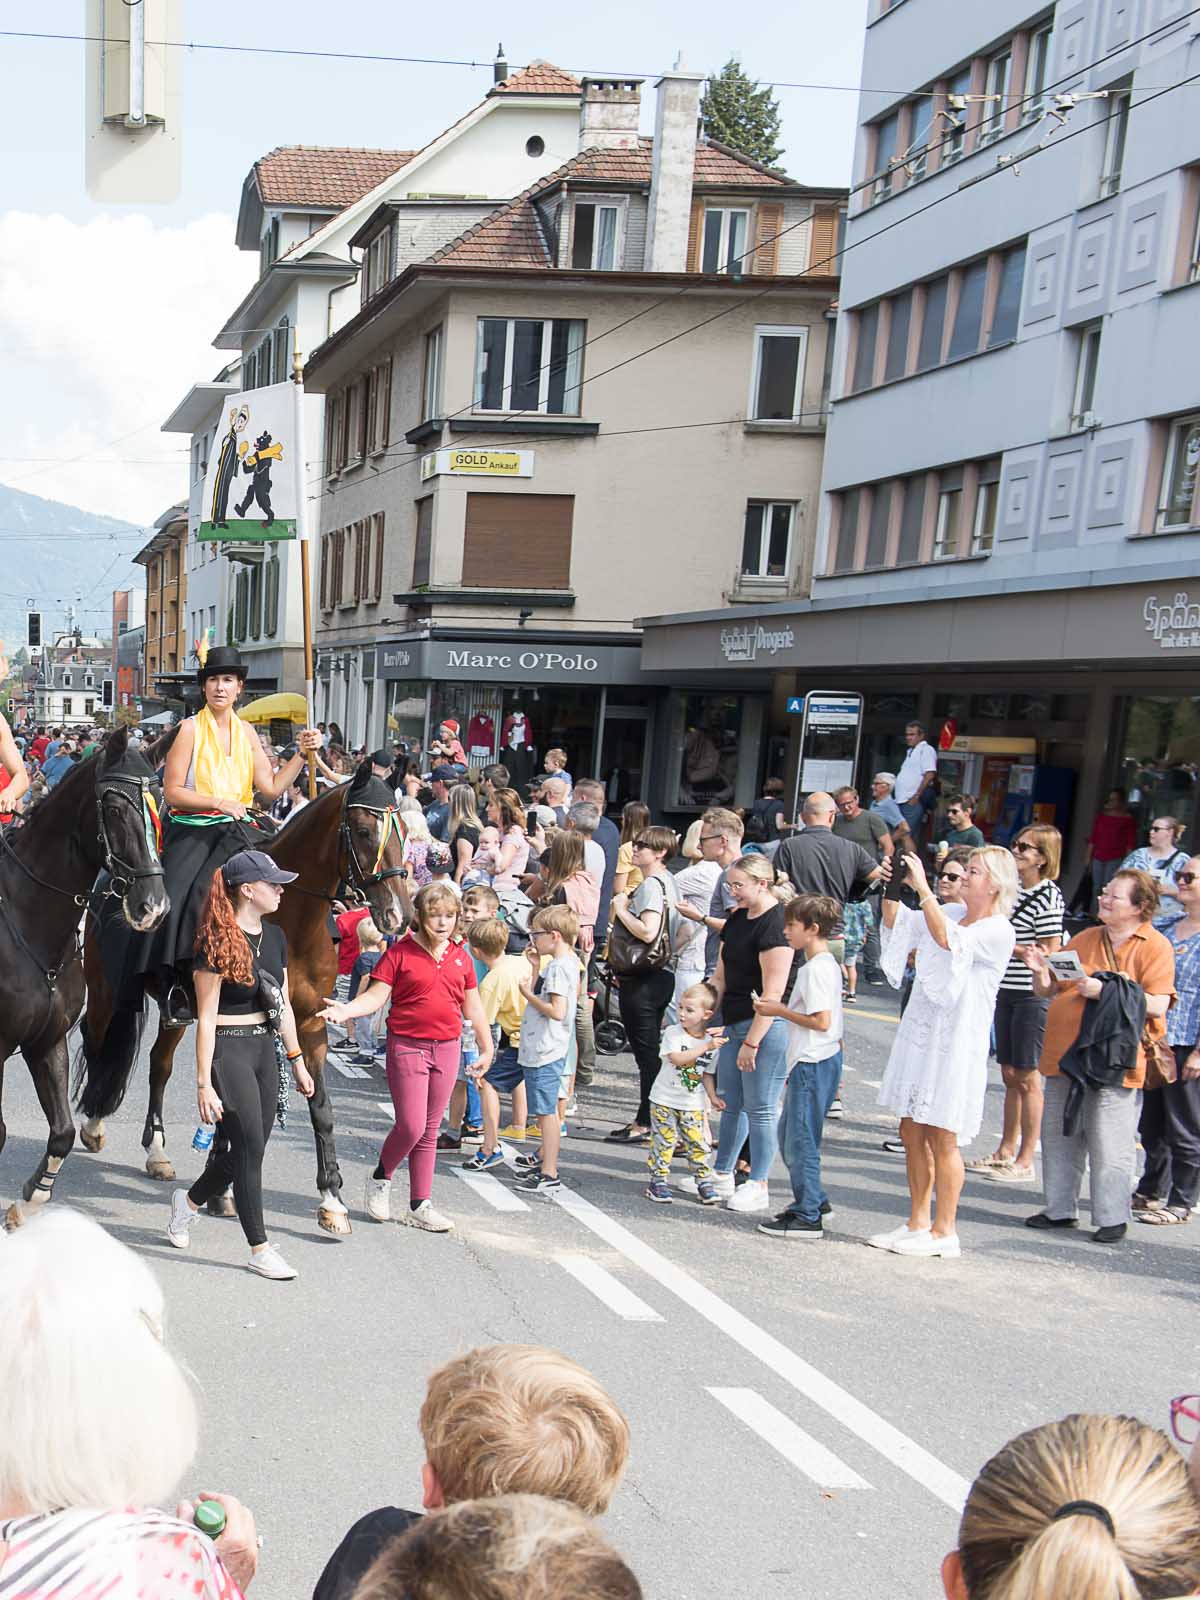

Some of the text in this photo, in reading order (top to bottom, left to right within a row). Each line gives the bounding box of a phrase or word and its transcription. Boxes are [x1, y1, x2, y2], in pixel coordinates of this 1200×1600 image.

[456, 454, 487, 465] GOLD
[447, 650, 598, 670] Marc O'Polo
[789, 700, 800, 711] A
